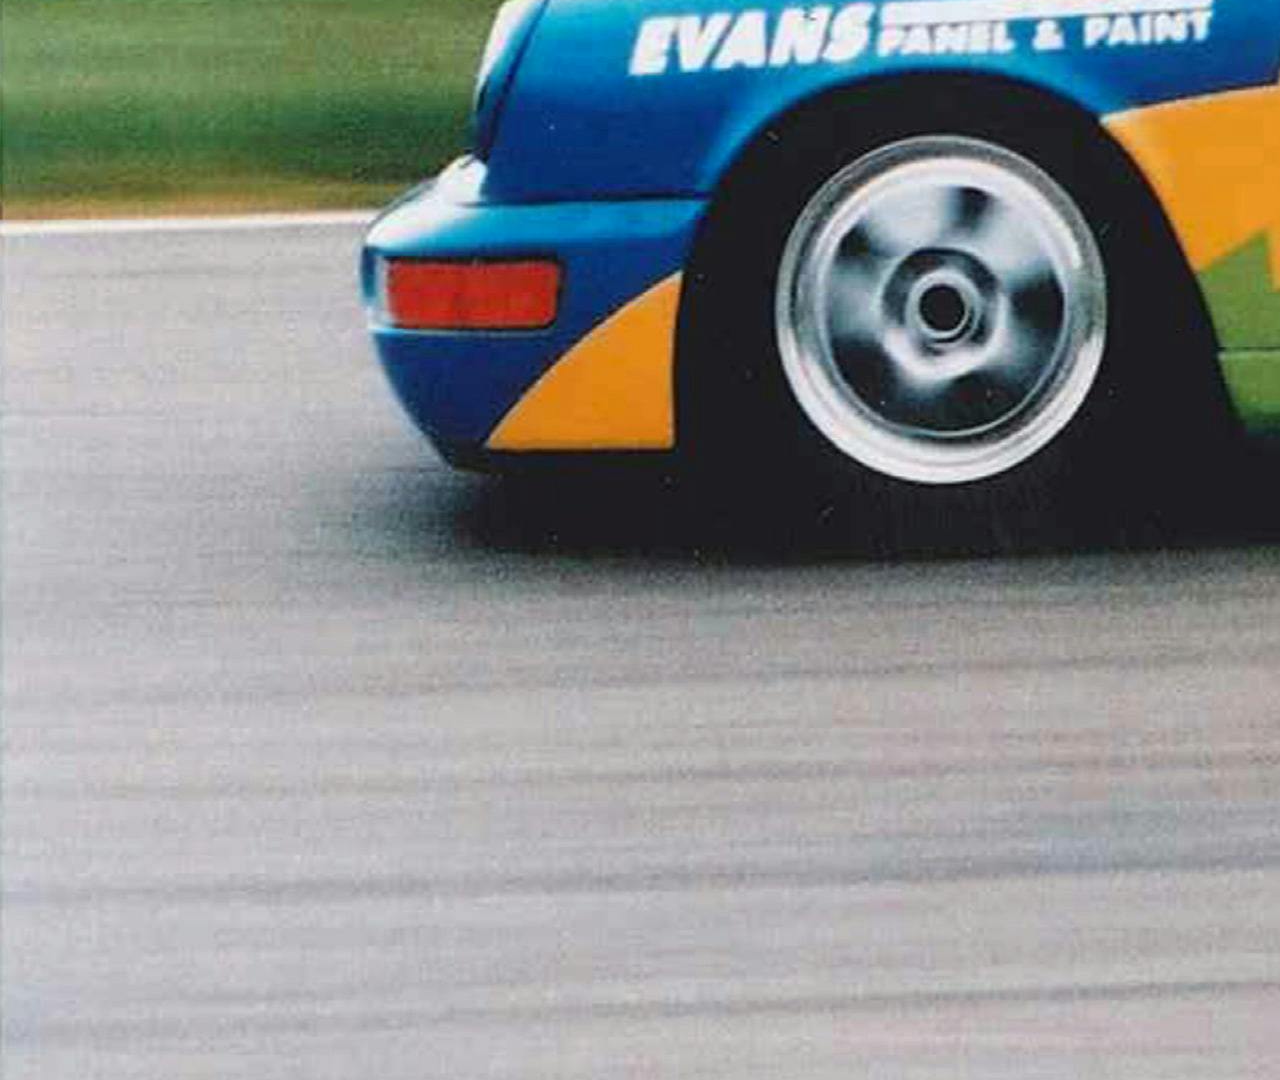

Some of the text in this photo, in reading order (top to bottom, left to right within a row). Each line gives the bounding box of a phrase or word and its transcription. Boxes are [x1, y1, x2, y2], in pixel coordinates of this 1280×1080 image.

[628, 1, 875, 76] EVANS
[876, 9, 1214, 58] PANEL & PAINT
